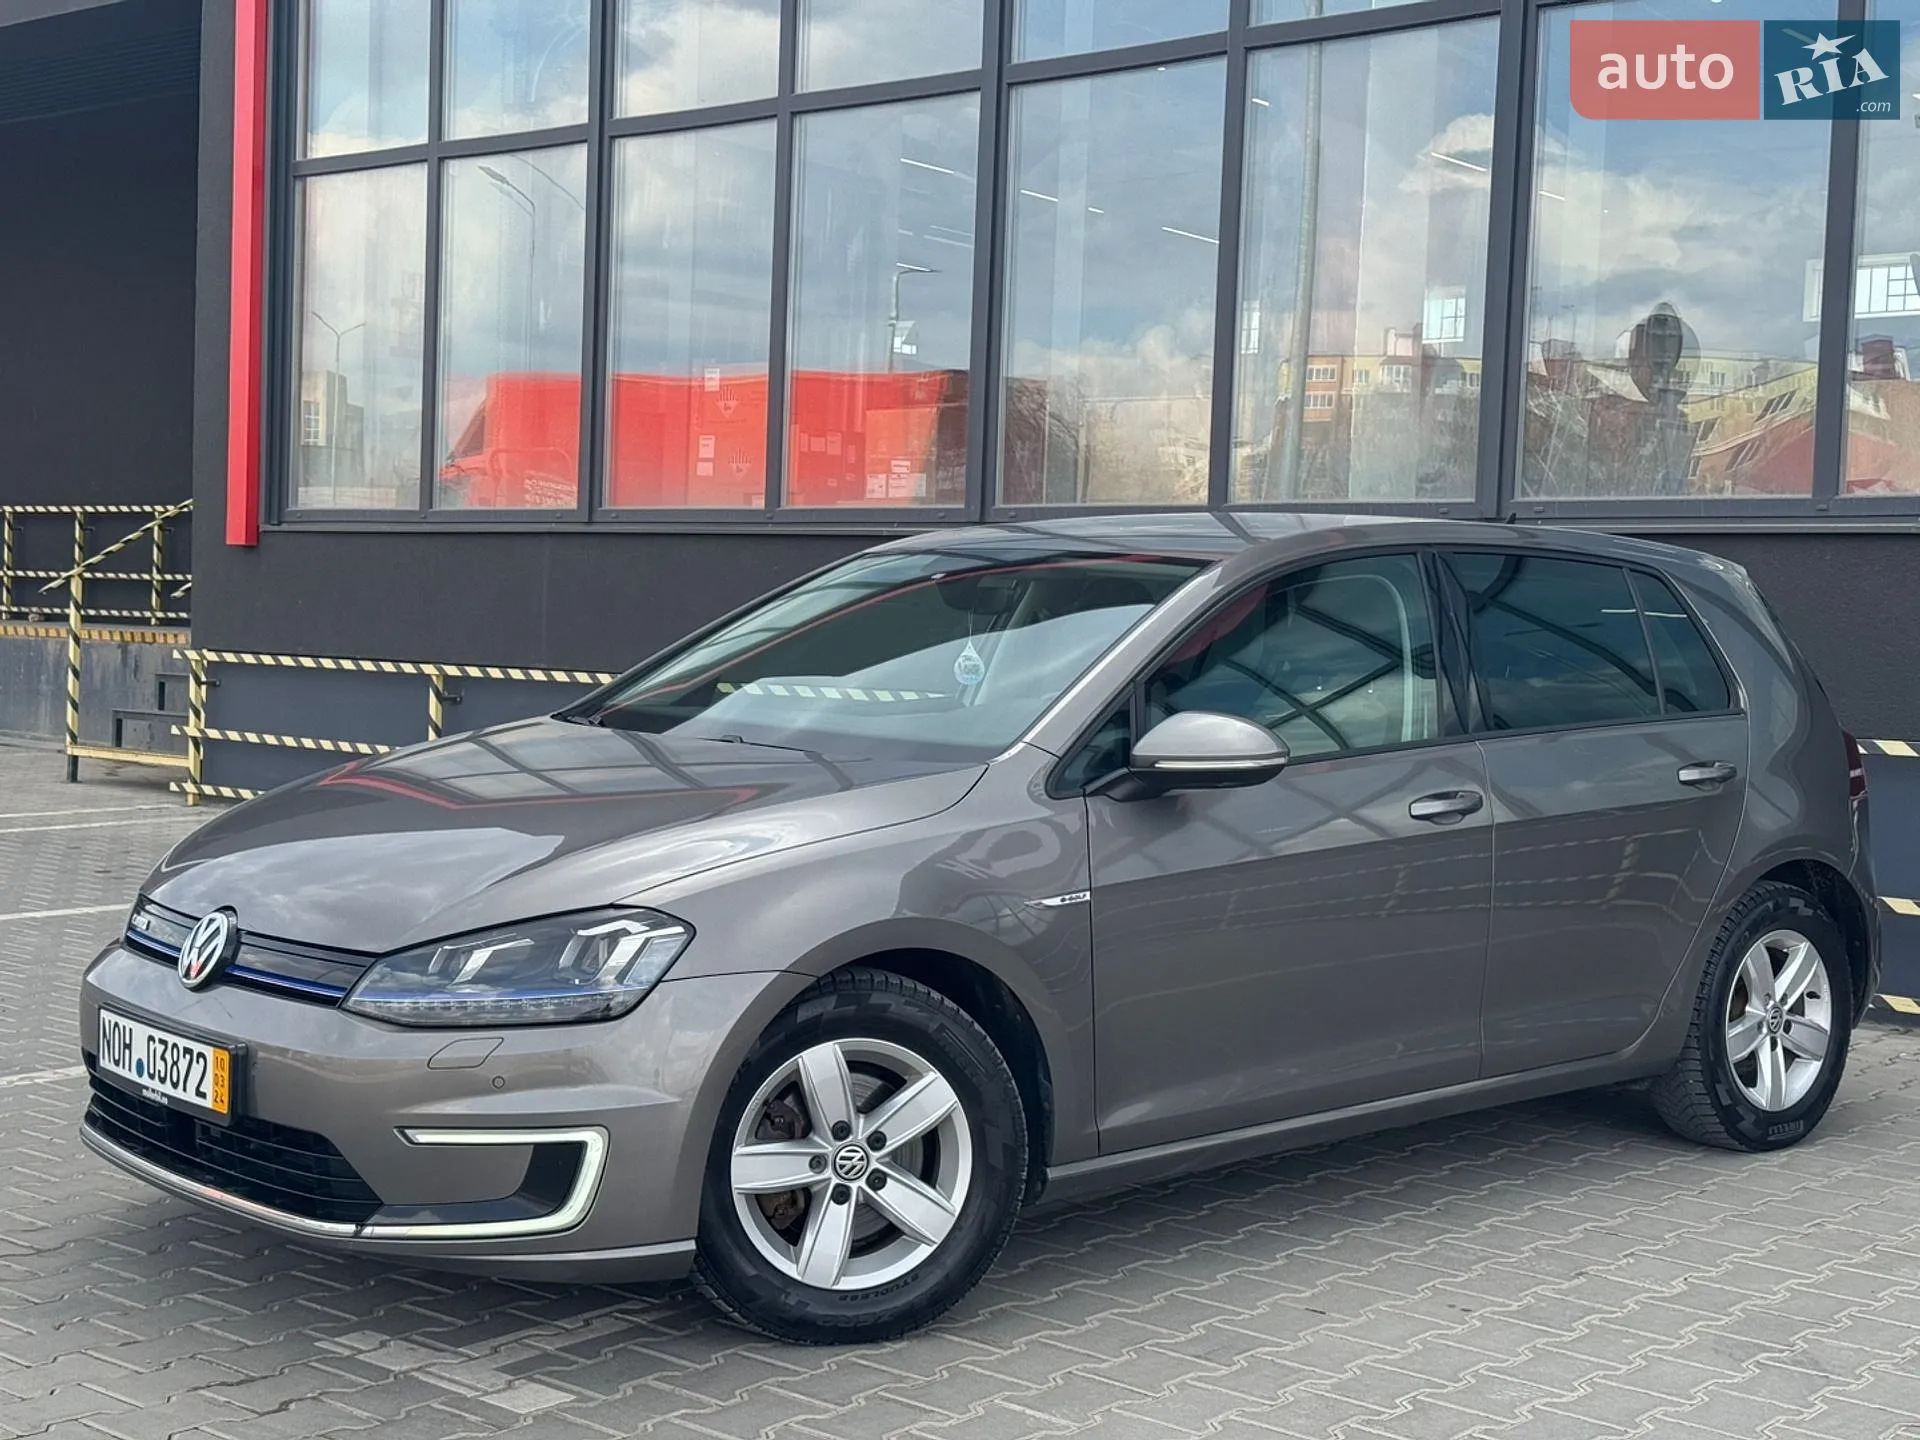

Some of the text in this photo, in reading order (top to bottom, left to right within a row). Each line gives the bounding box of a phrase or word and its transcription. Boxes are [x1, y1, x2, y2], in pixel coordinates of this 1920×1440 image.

[102, 1016, 208, 1100] NOH 03872
[215, 1055, 226, 1073] 10
